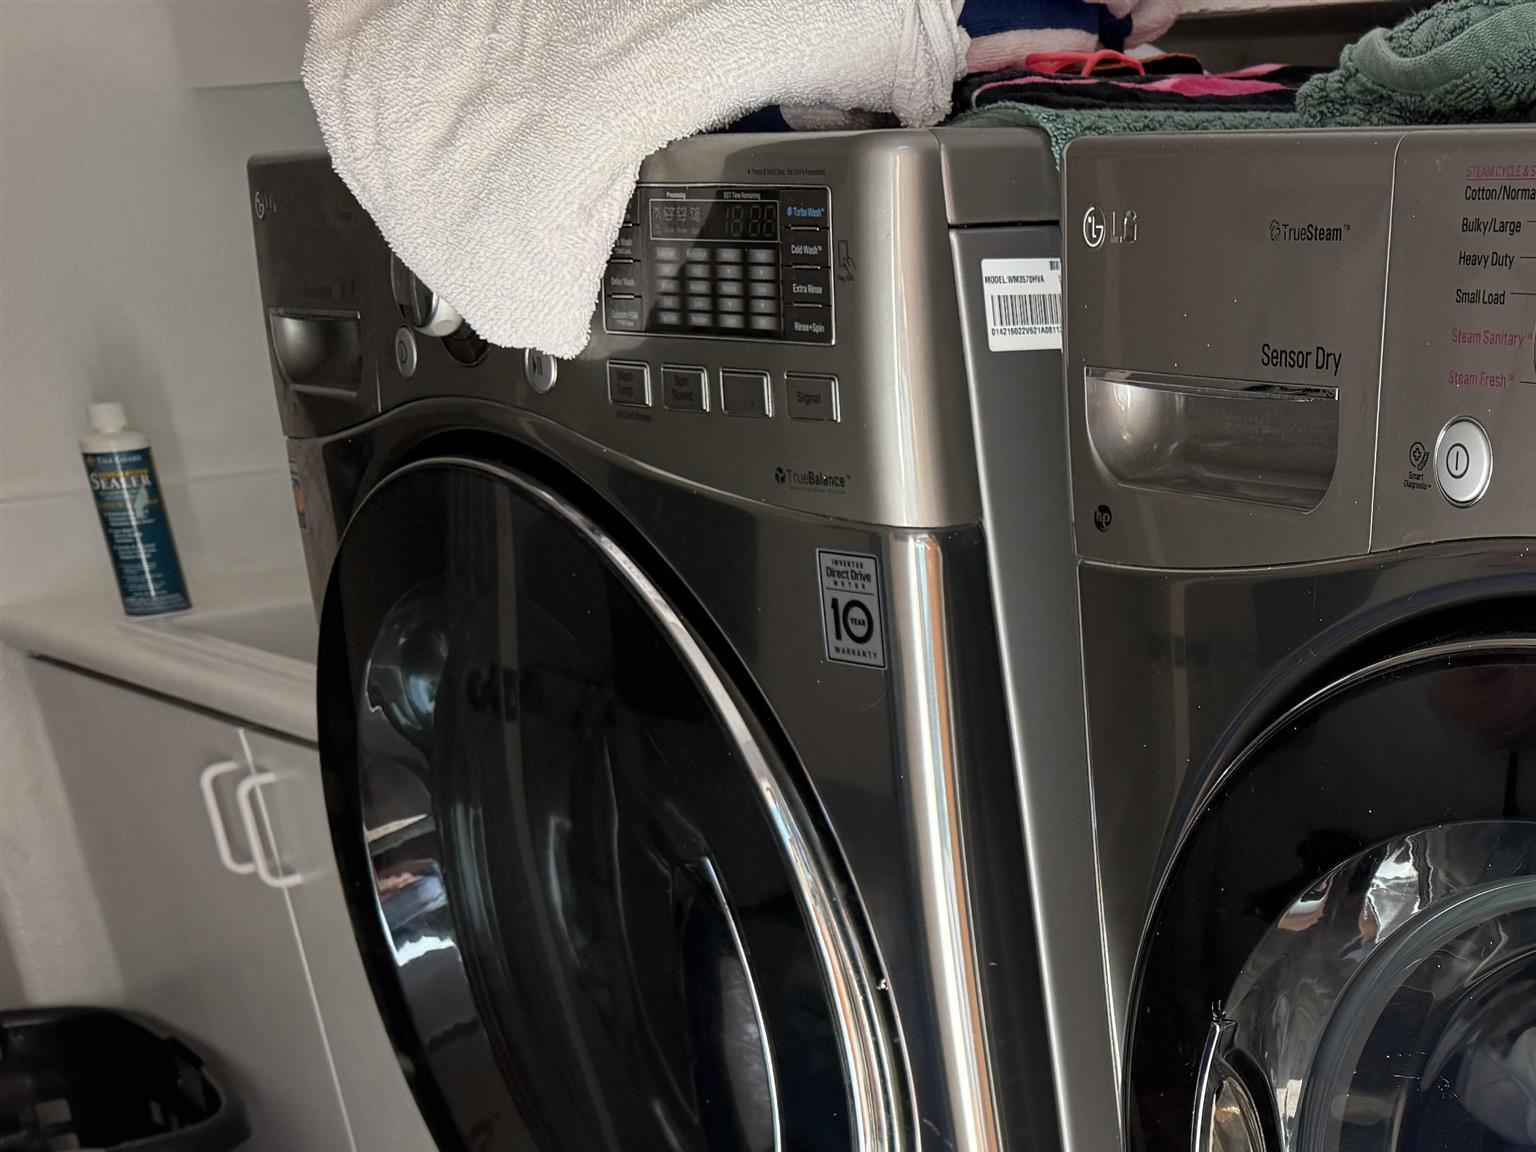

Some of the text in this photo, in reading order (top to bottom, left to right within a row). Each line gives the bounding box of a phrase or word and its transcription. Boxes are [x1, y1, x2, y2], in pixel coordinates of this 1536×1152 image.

[1461, 217, 1522, 236] Bulky/Large
[1458, 251, 1515, 270] Heavy Duty
[1455, 288, 1506, 305] Small Load
[1451, 328, 1481, 344] Steam
[1261, 343, 1342, 376] Sensor Dry
[1449, 369, 1480, 386] Steam
[826, 567, 872, 583] Direct Drive
[831, 597, 874, 645] 10
[850, 617, 866, 627] YEAR
[834, 646, 878, 660] WARRANTY
